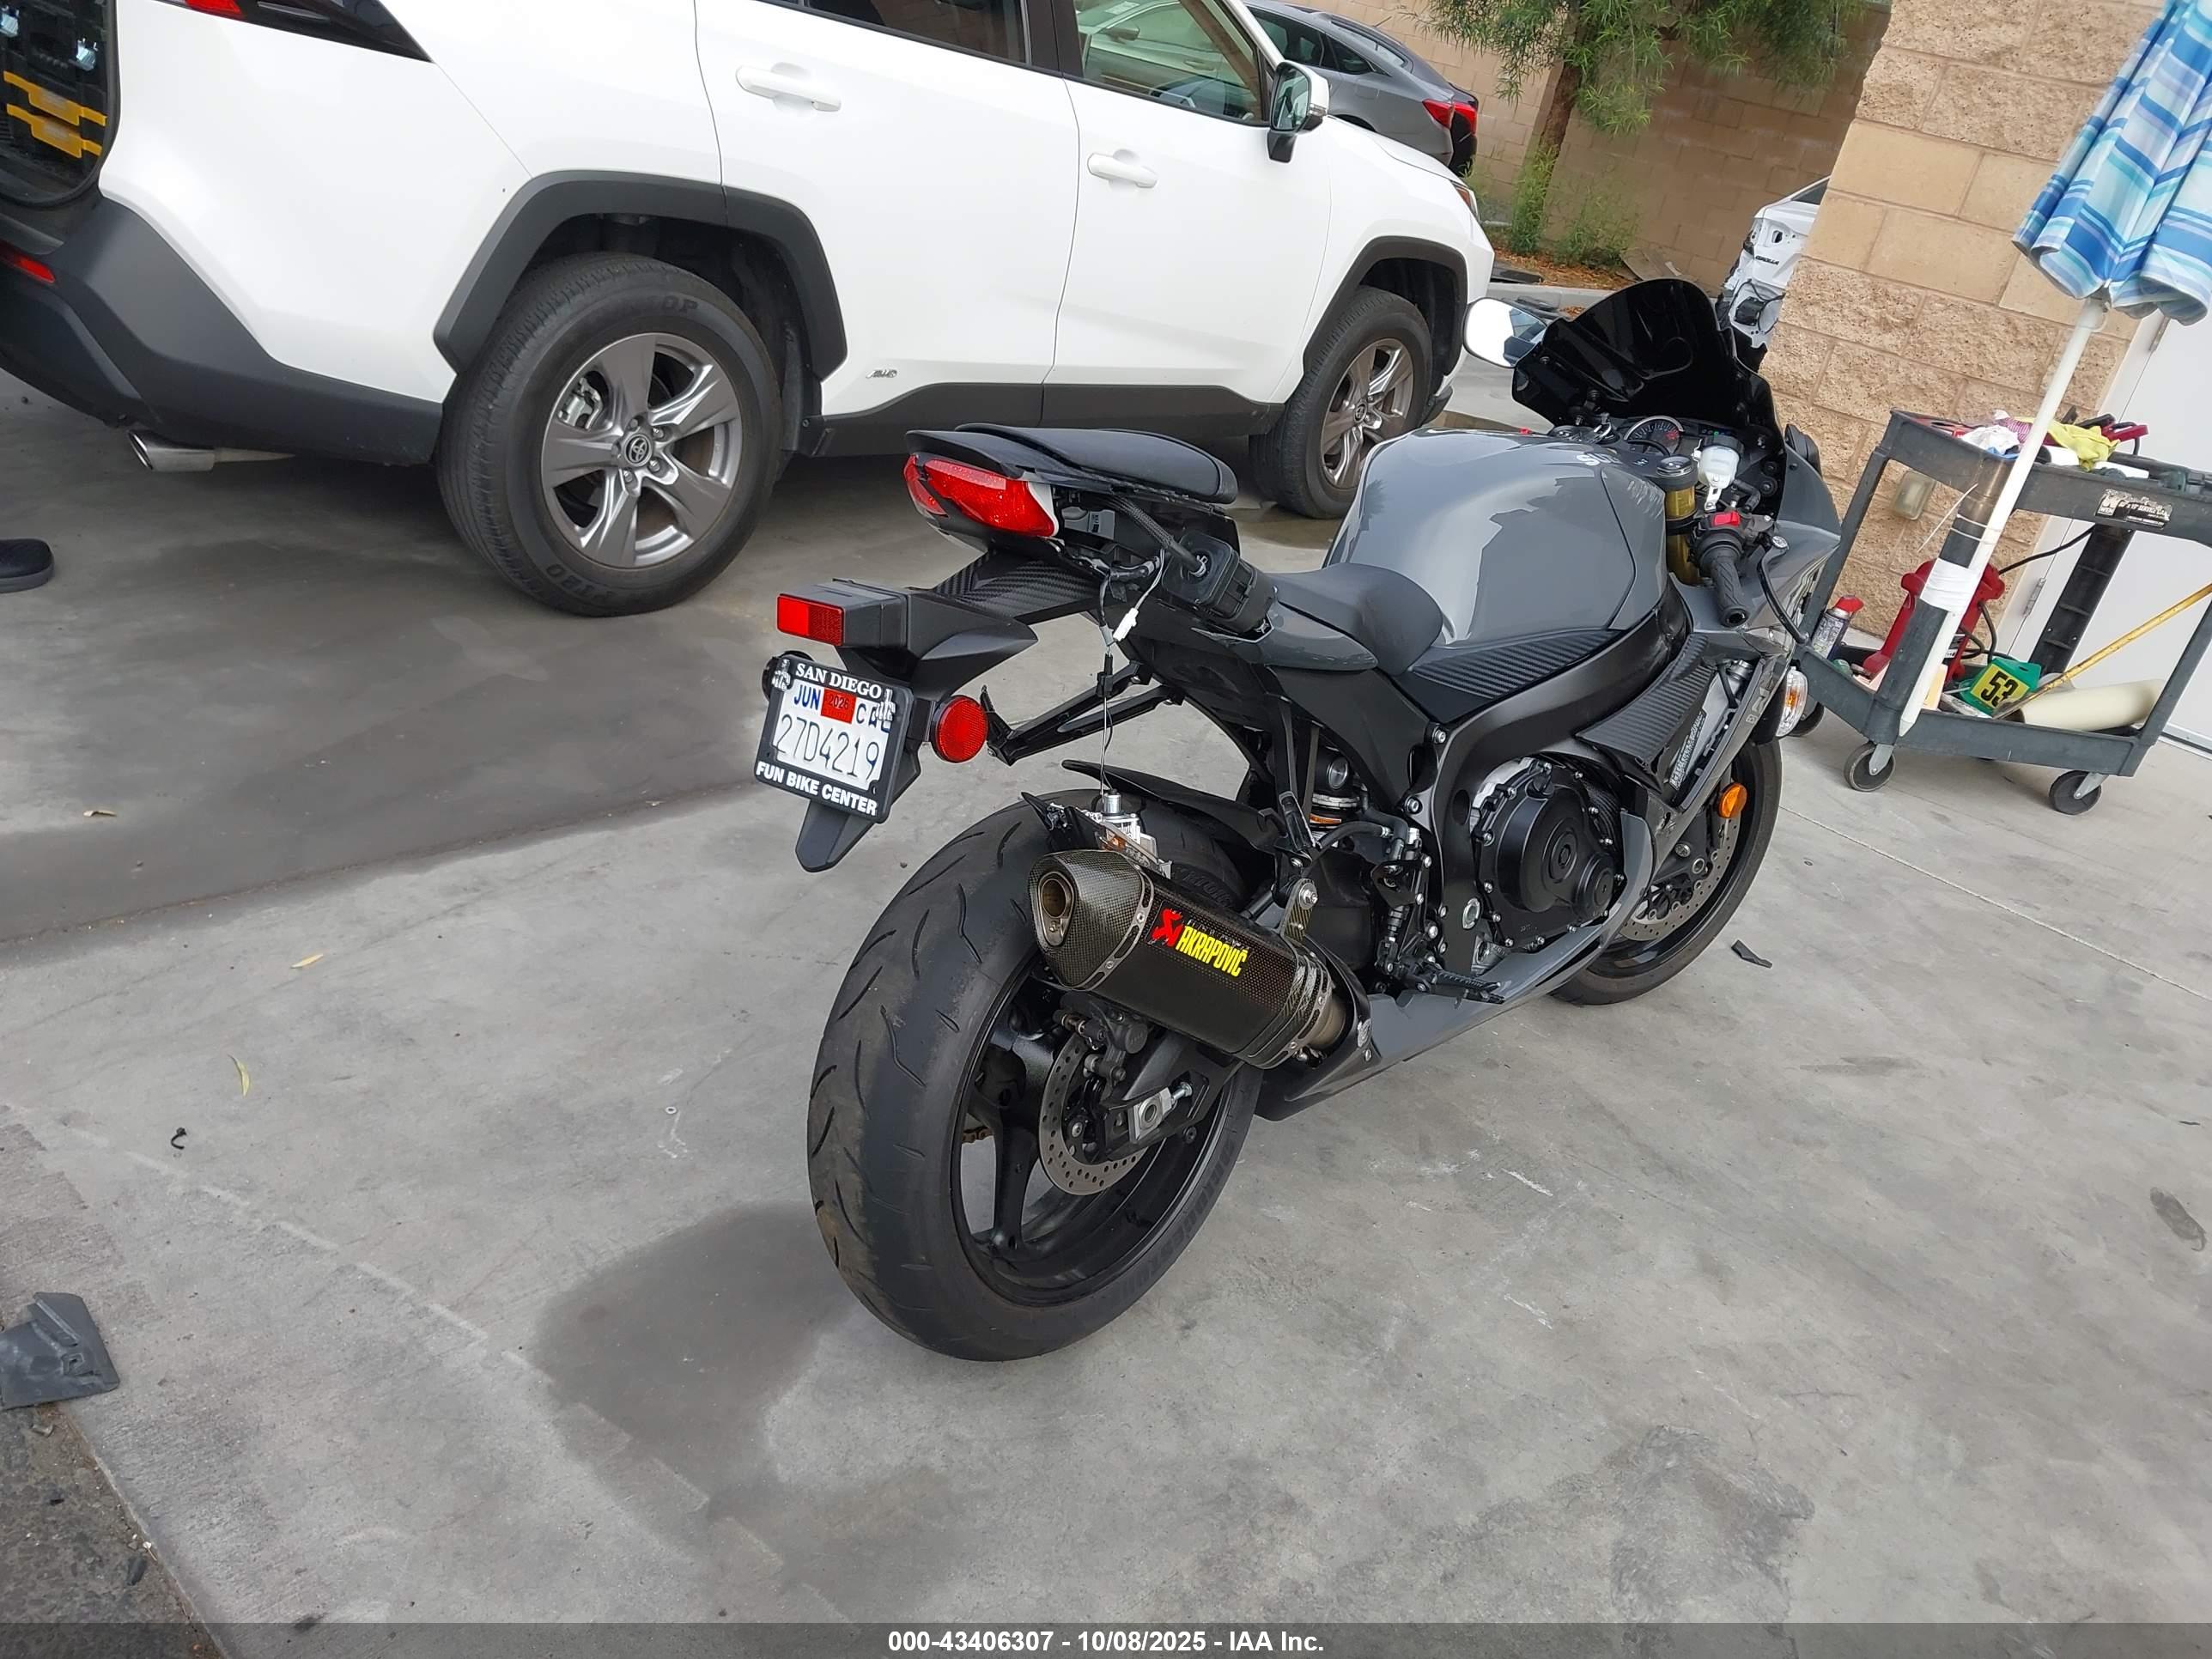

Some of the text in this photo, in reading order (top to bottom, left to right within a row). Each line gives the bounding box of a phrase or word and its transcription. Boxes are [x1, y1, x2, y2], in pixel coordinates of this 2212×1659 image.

[793, 685, 821, 711] JUN
[796, 663, 881, 699] SAN DIEGO
[1980, 670, 2019, 708] 53
[775, 714, 879, 781] 27D4219
[756, 761, 878, 816] FUN BIKE CENTER
